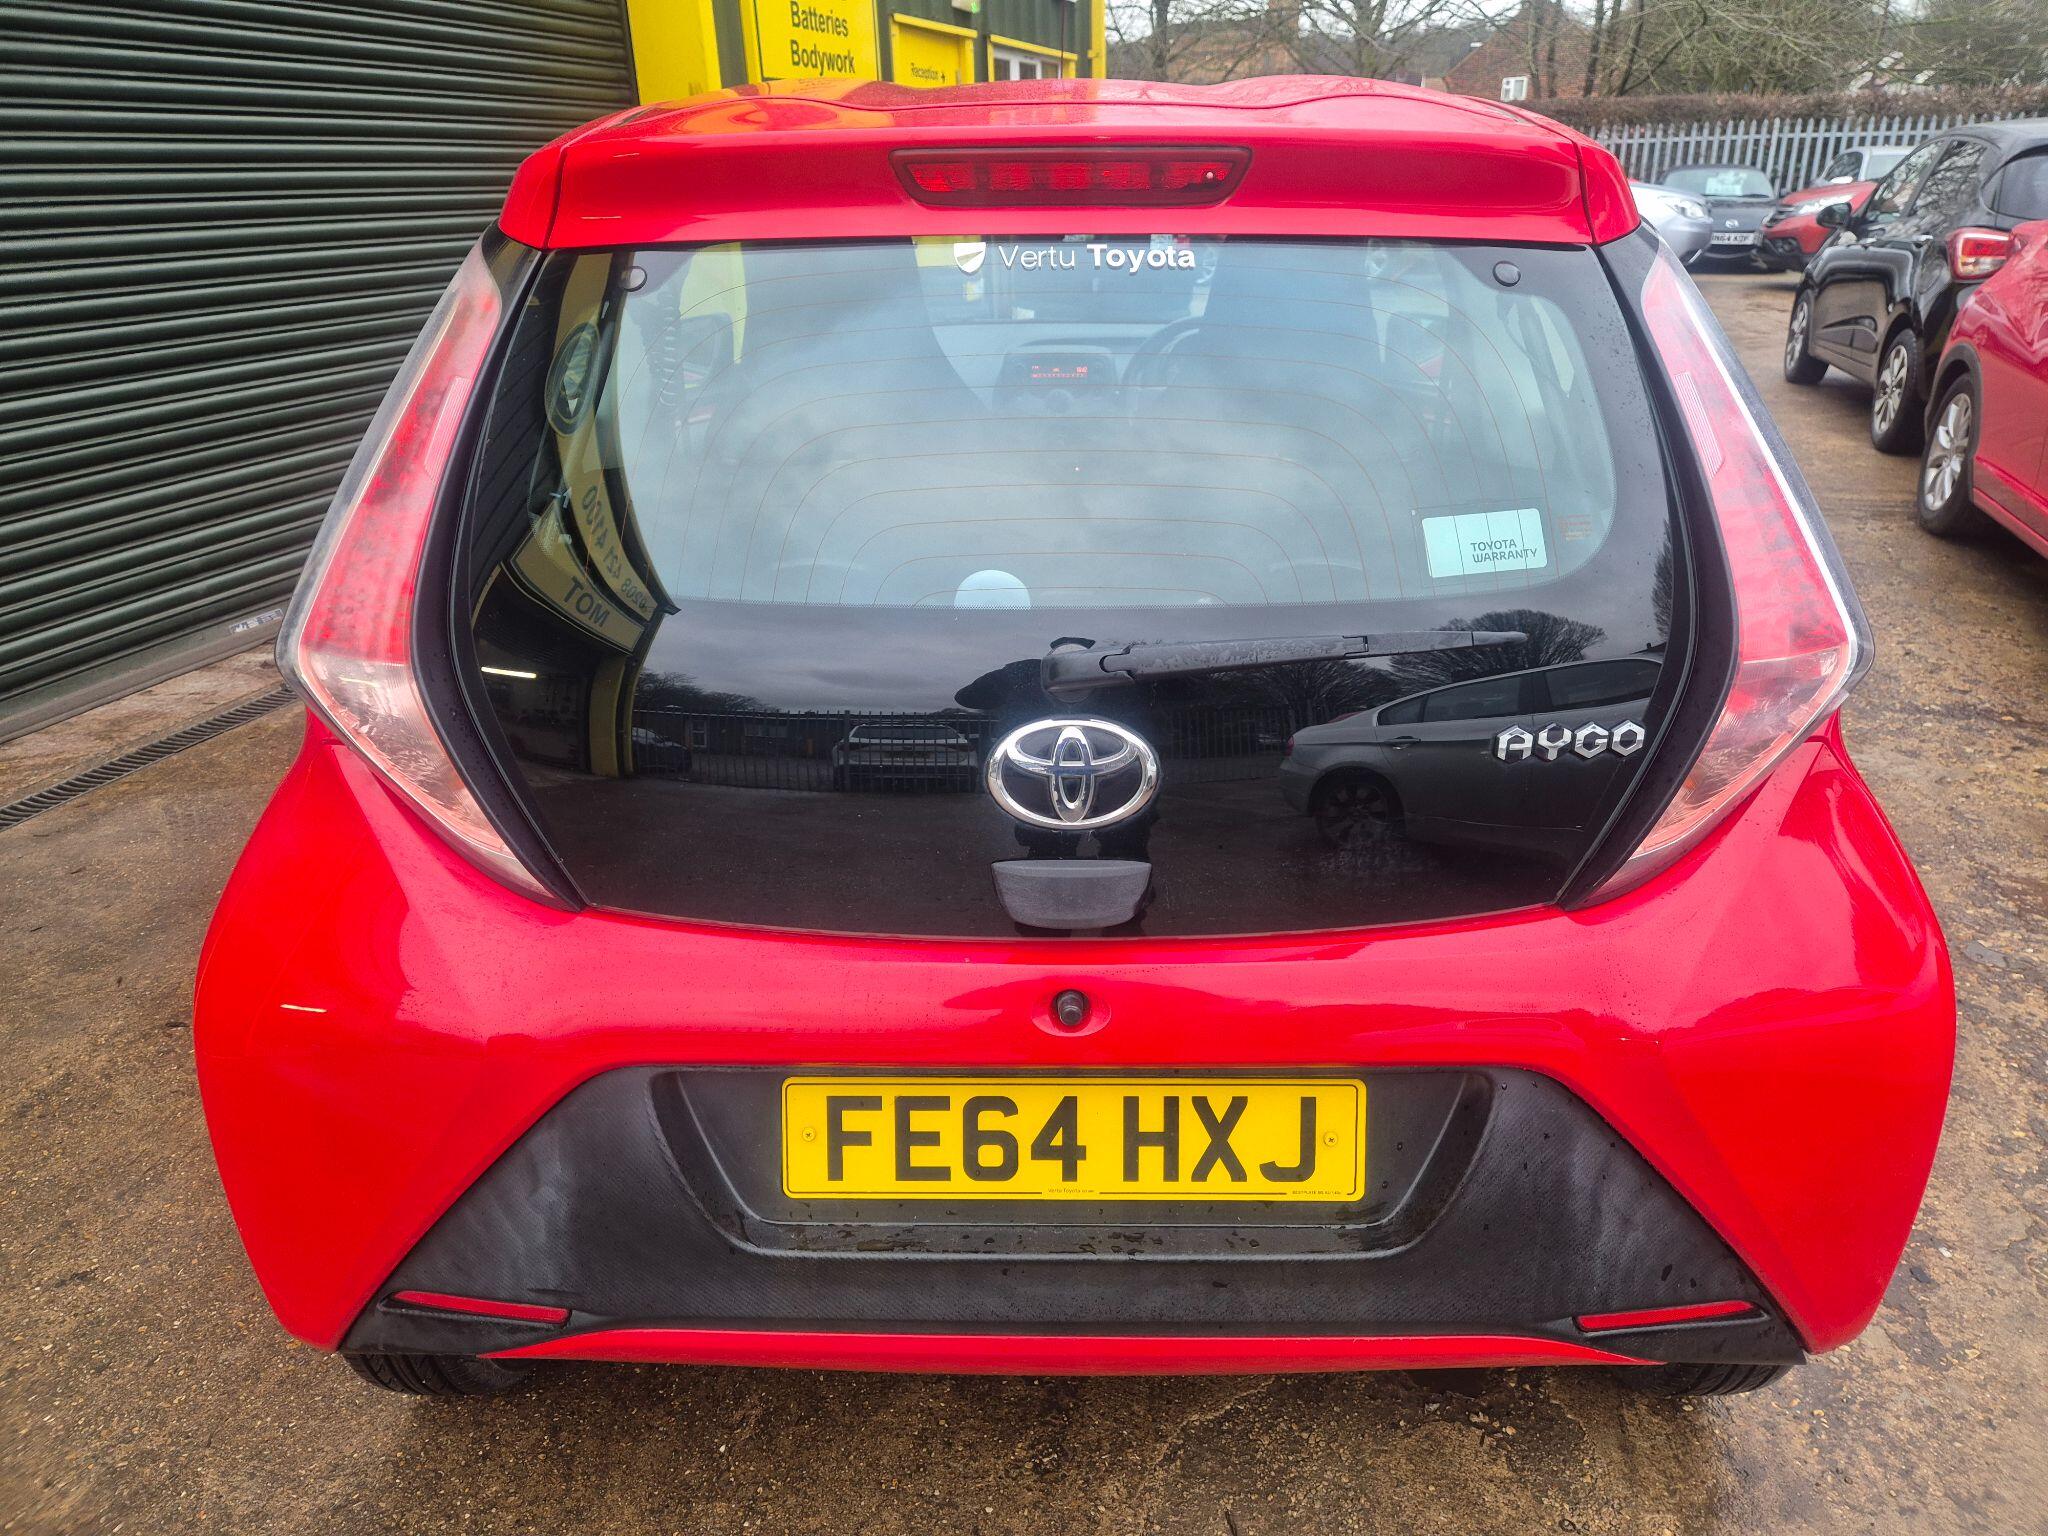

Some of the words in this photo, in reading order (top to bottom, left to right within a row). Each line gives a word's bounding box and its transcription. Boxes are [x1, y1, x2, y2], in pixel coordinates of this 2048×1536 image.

[791, 1, 849, 37] Batteries
[790, 39, 855, 76] Bodywork
[998, 244, 1075, 268] Vertu
[1086, 244, 1196, 272] Toyota
[1470, 538, 1517, 552] TOYOTA
[1472, 548, 1537, 563] WARRANTY
[1497, 719, 1645, 761] AYGO
[826, 1095, 1087, 1183] FE64
[1122, 1095, 1317, 1183] HXJ
